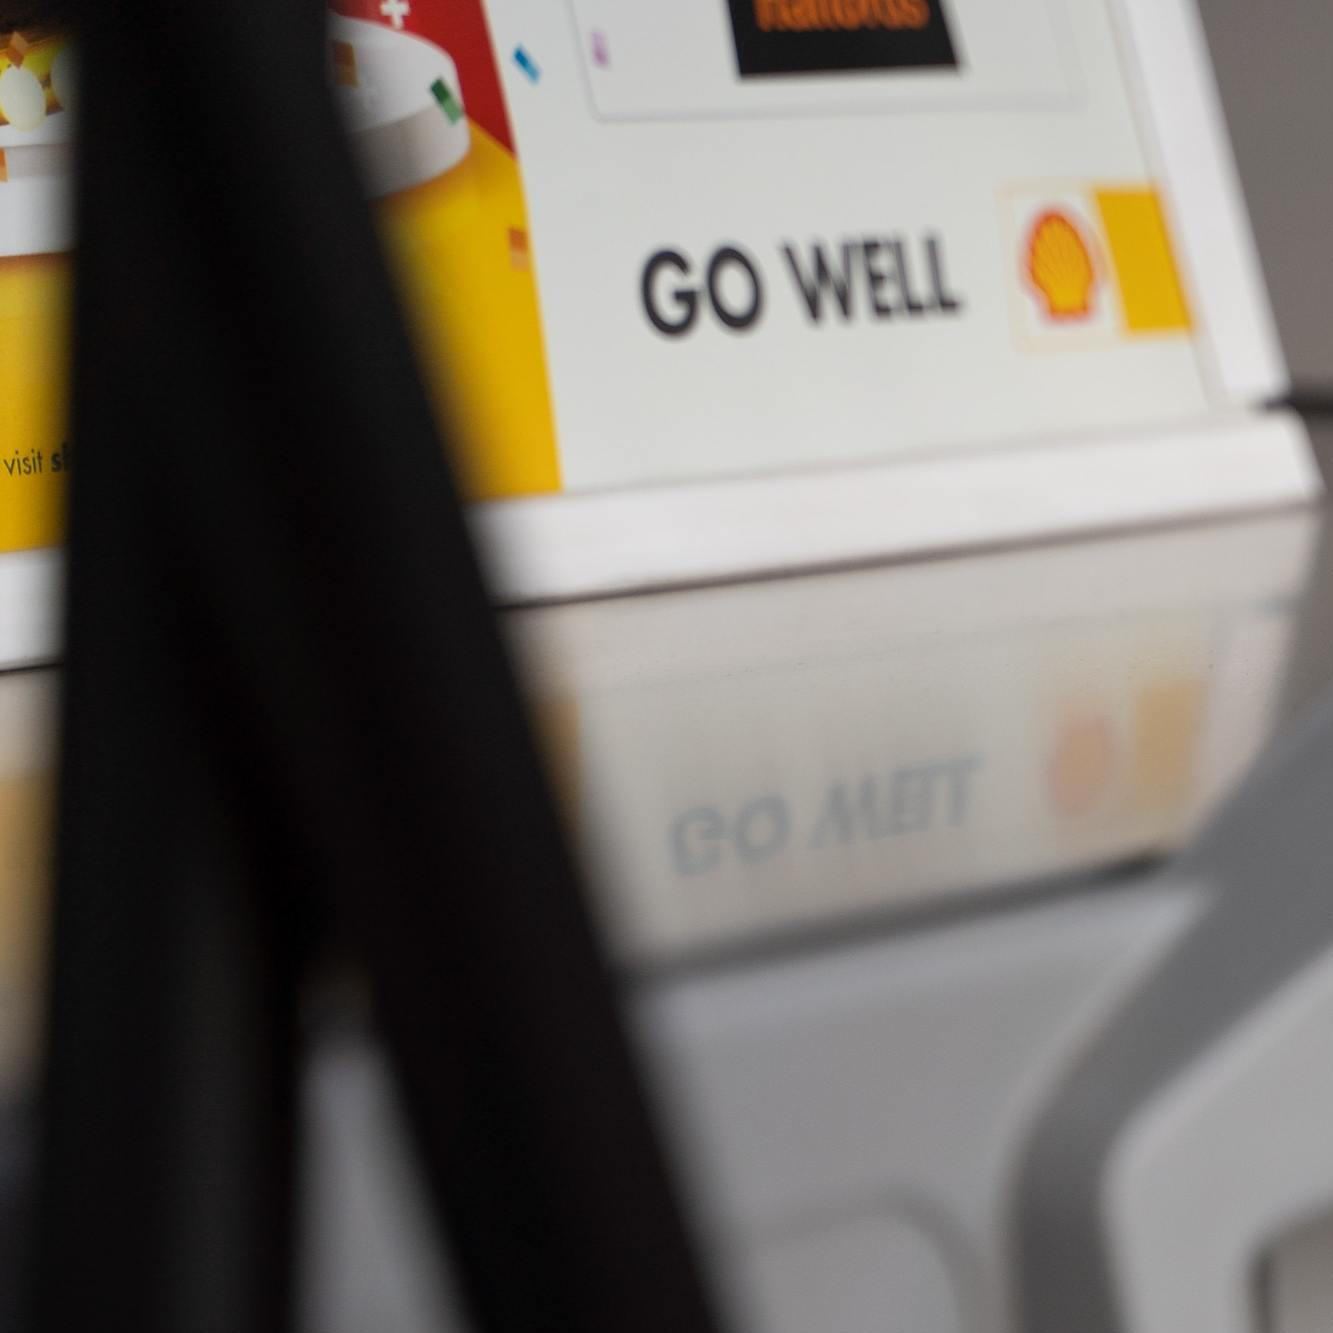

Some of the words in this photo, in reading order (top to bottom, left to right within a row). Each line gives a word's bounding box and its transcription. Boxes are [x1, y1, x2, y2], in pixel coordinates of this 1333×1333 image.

[641, 249, 763, 338] GO
[782, 232, 962, 324] WELL
[3, 448, 43, 476] visit
